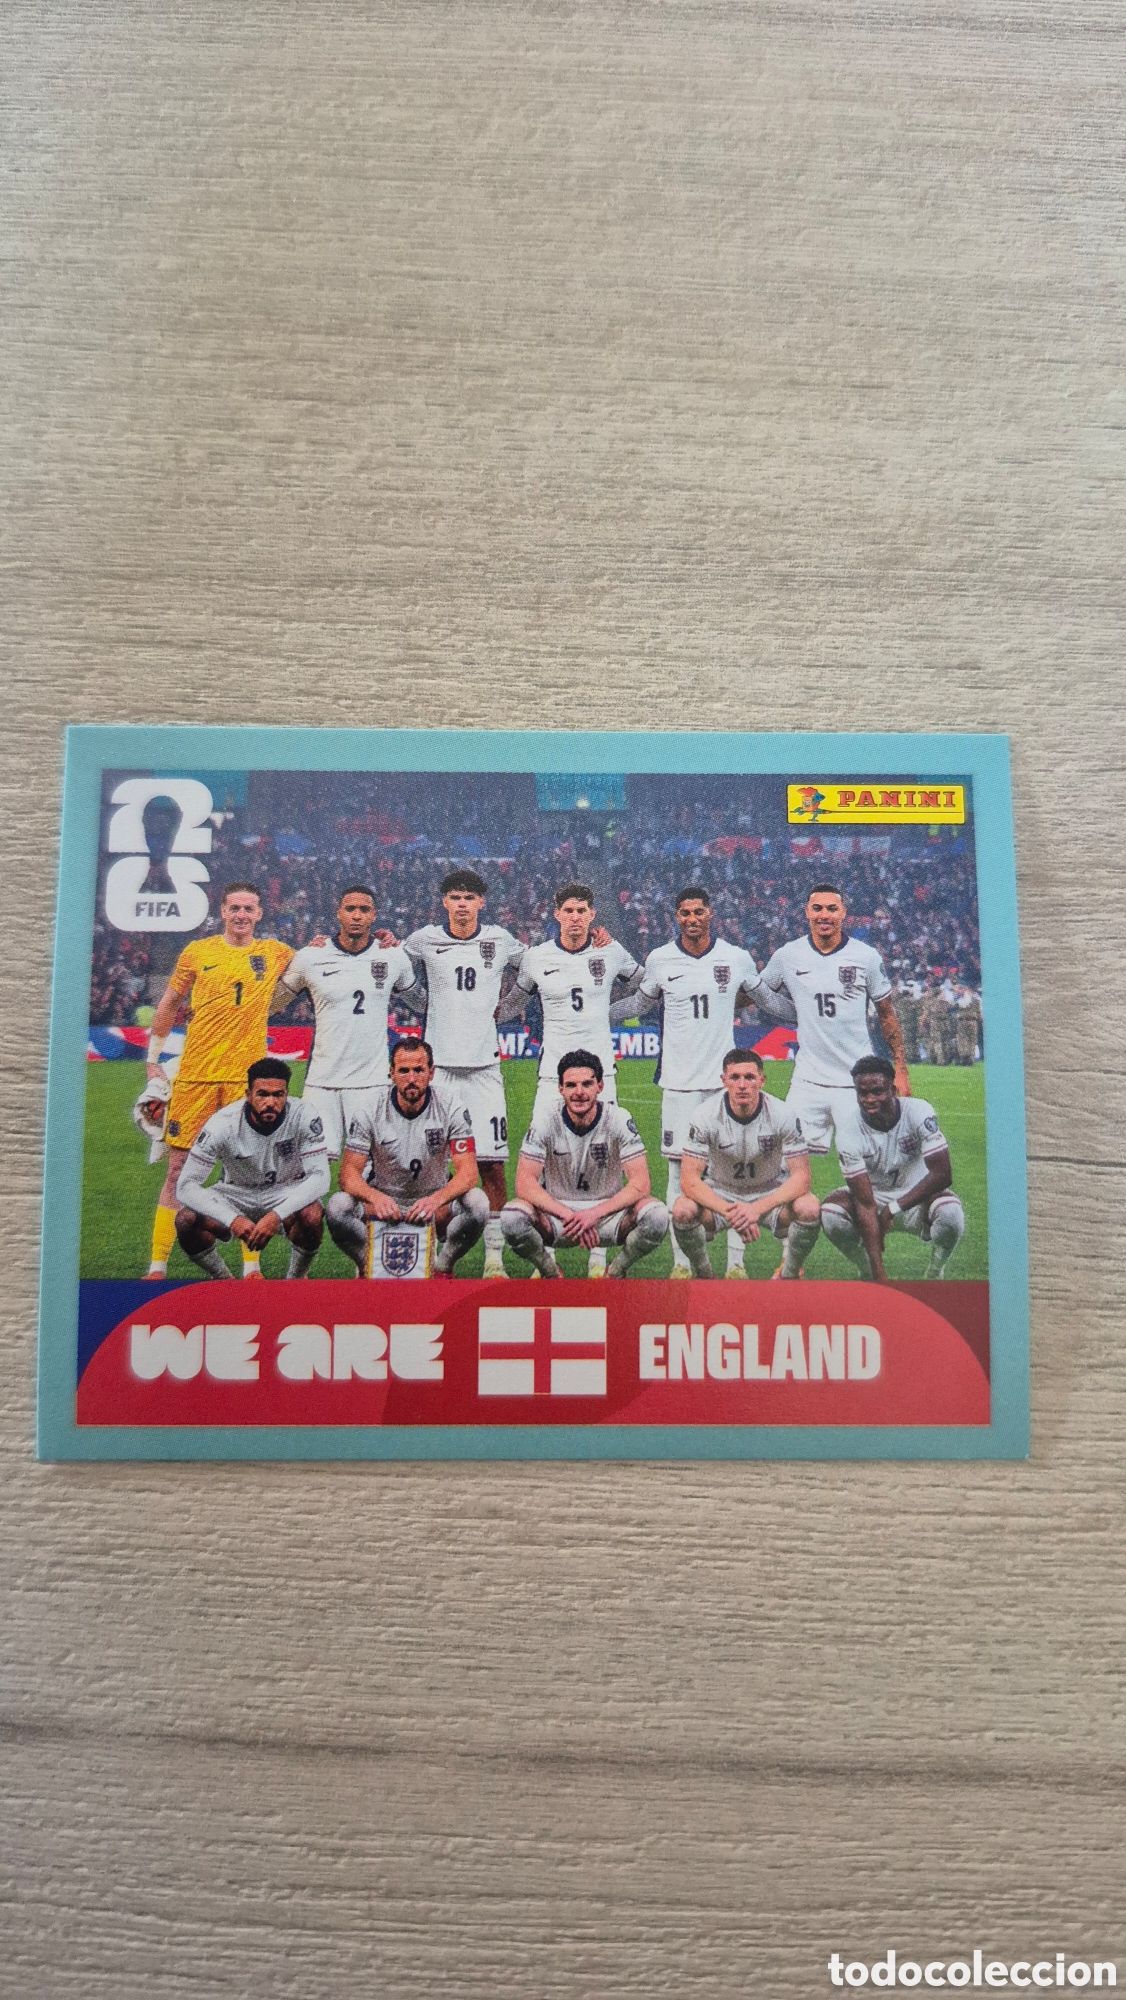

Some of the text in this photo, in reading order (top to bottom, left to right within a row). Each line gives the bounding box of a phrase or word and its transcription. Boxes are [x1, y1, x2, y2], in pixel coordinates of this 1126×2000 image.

[837, 790, 956, 808] PANINI
[135, 901, 181, 918] FIFA
[455, 965, 477, 992] 18
[234, 981, 243, 1006] 1
[352, 989, 366, 1015] 2
[570, 986, 584, 1012] 5
[814, 992, 837, 1018] 15
[690, 994, 709, 1019] 11
[490, 1115, 508, 1142] 18
[455, 1139, 468, 1153] C
[264, 1170, 277, 1185] 3
[409, 1158, 422, 1180] 9
[732, 1161, 757, 1180] 21
[887, 1169, 900, 1187] 7
[577, 1172, 590, 1192] 4
[131, 1323, 881, 1380] WE ARE ENGLAND
